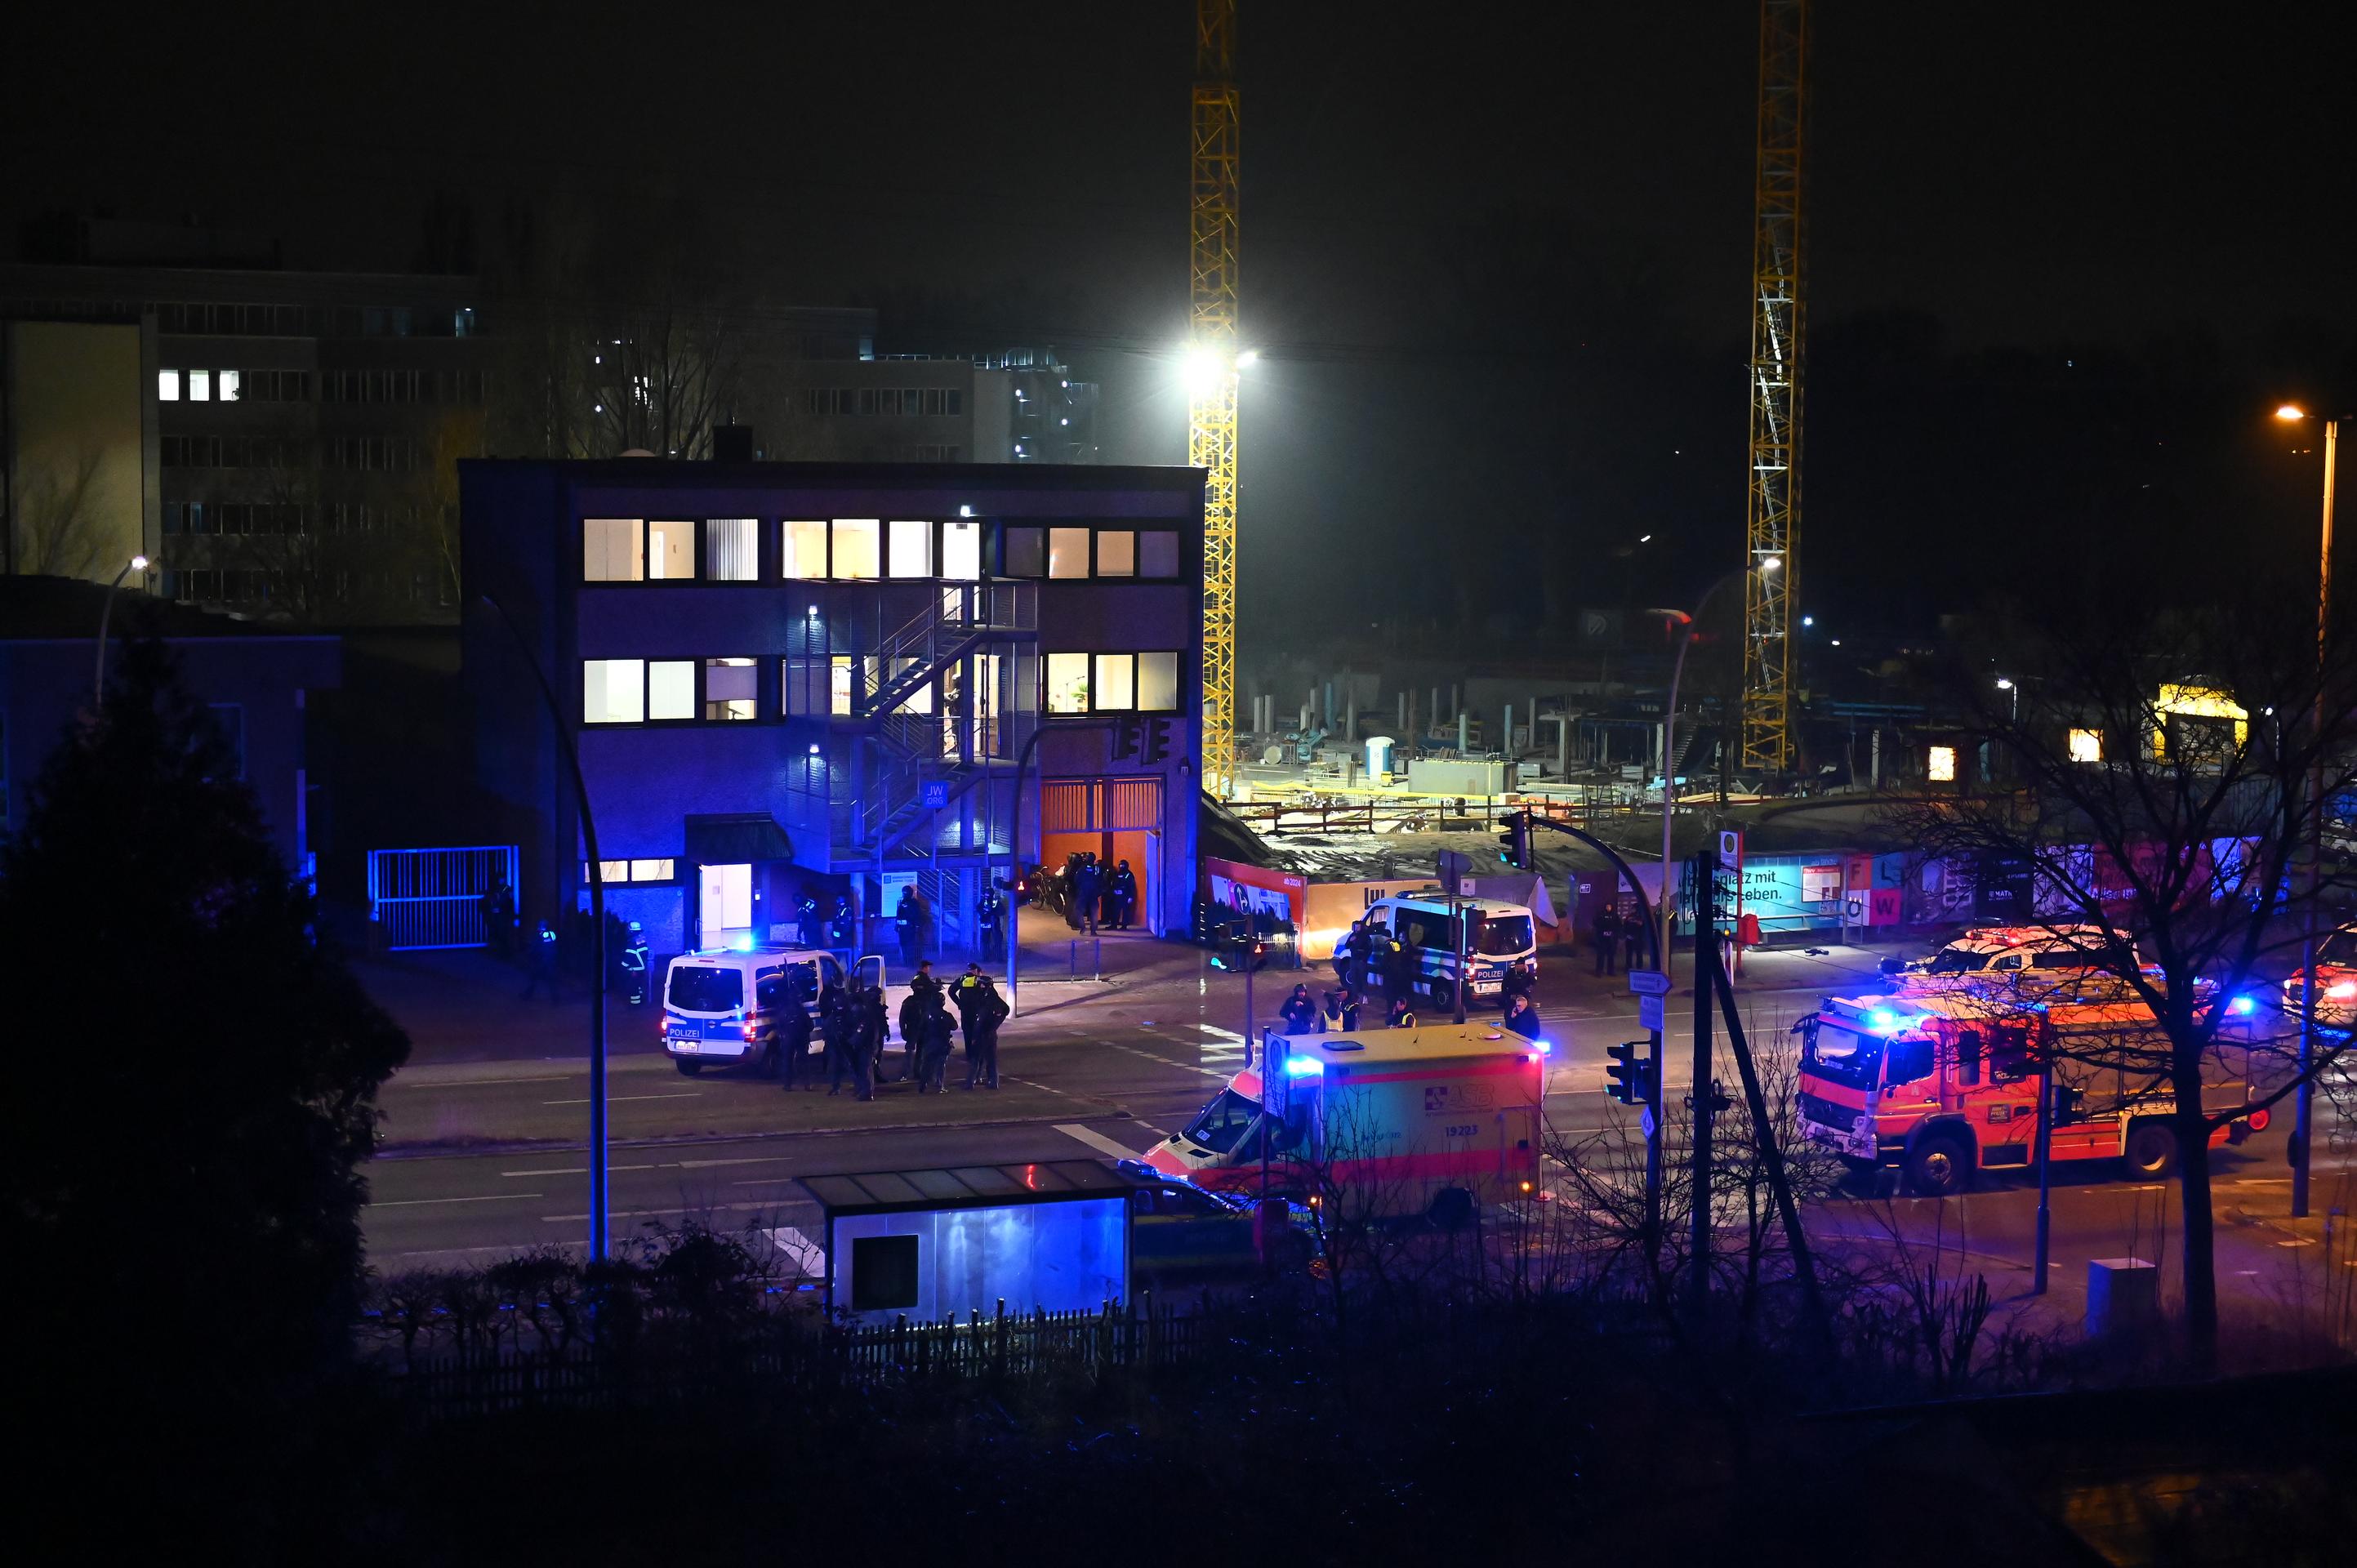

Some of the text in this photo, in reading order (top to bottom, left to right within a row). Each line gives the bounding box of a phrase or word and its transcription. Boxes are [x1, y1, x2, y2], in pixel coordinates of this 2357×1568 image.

[927, 785, 943, 796] JW
[1755, 870, 1776, 884] mit
[1477, 969, 1504, 978] POLIZEI
[670, 1028, 700, 1038] POLIZEI
